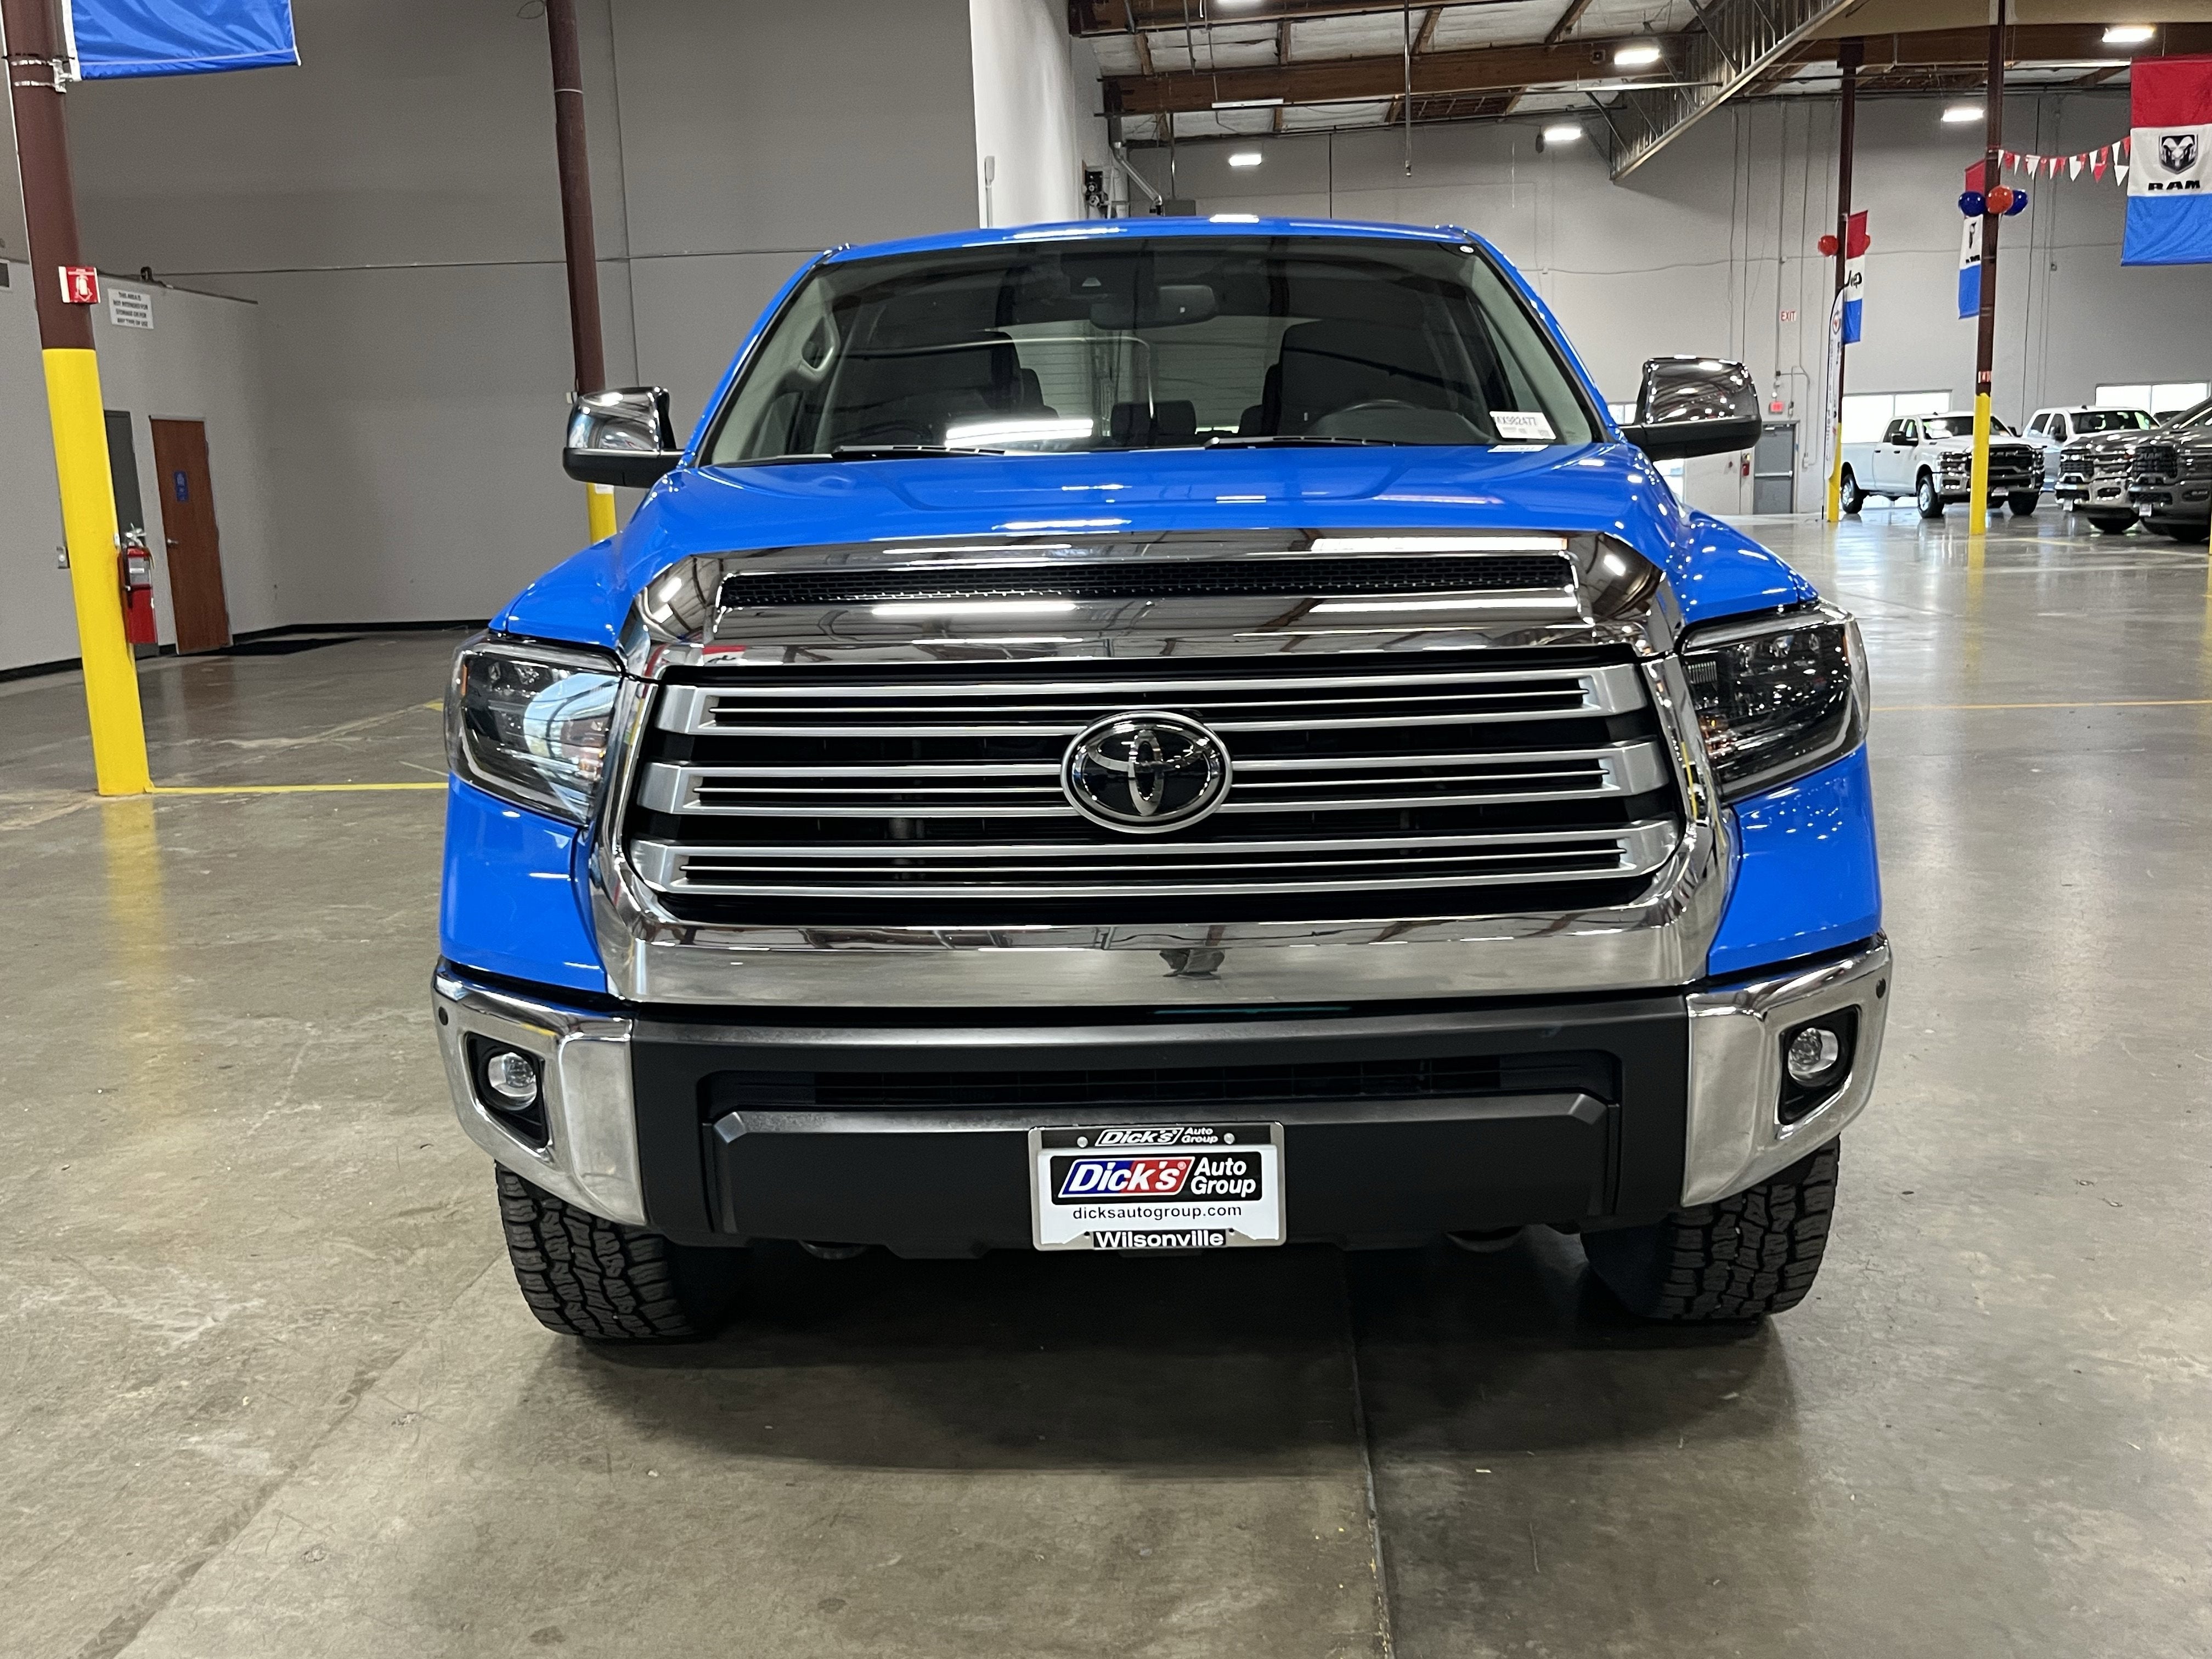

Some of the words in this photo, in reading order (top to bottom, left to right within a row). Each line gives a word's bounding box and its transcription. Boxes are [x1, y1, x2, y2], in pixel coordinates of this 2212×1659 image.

[2148, 180, 2200, 190] RAM
[1781, 311, 1795, 321] EXIT
[1103, 1129, 1175, 1144] Dick's
[1186, 1127, 1213, 1135] Auto
[1182, 1135, 1218, 1144] Group
[1068, 1161, 1180, 1192] Dick's
[1194, 1158, 1247, 1177] Auto
[1190, 1176, 1256, 1198] Group
[1073, 1205, 1242, 1221] dicksautogroup.com
[1096, 1229, 1224, 1248] Wilsonville
